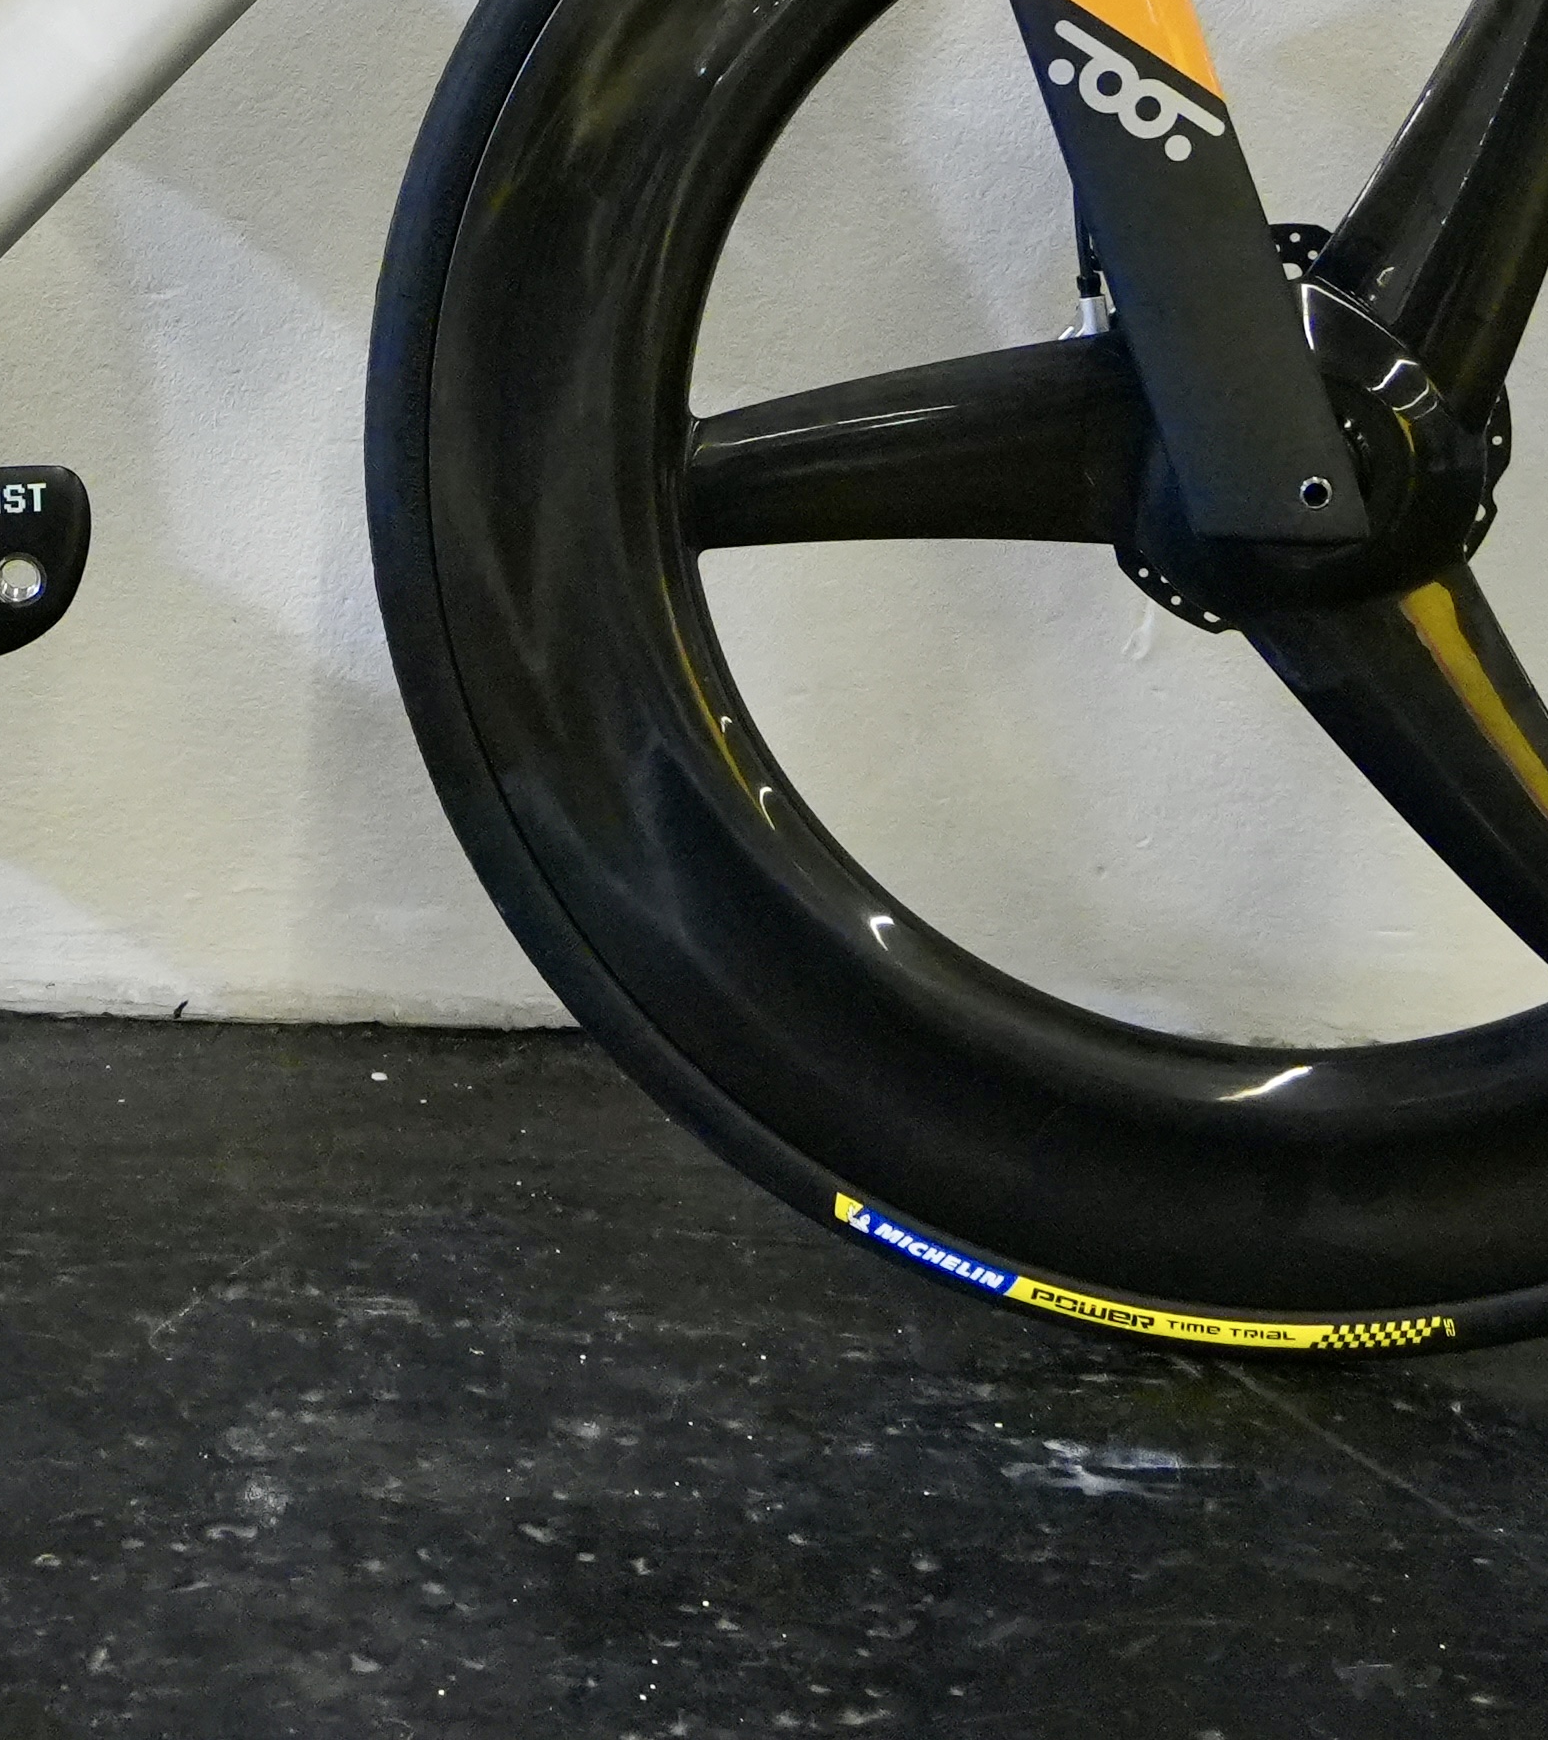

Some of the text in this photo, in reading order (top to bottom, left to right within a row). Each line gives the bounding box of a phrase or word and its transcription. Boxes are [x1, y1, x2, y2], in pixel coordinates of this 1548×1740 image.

[873, 1221, 1006, 1290] MICHELIN
[1030, 1286, 1155, 1331] POWER
[1166, 1319, 1222, 1336] TIME
[1229, 1327, 1296, 1342] TRIAL
